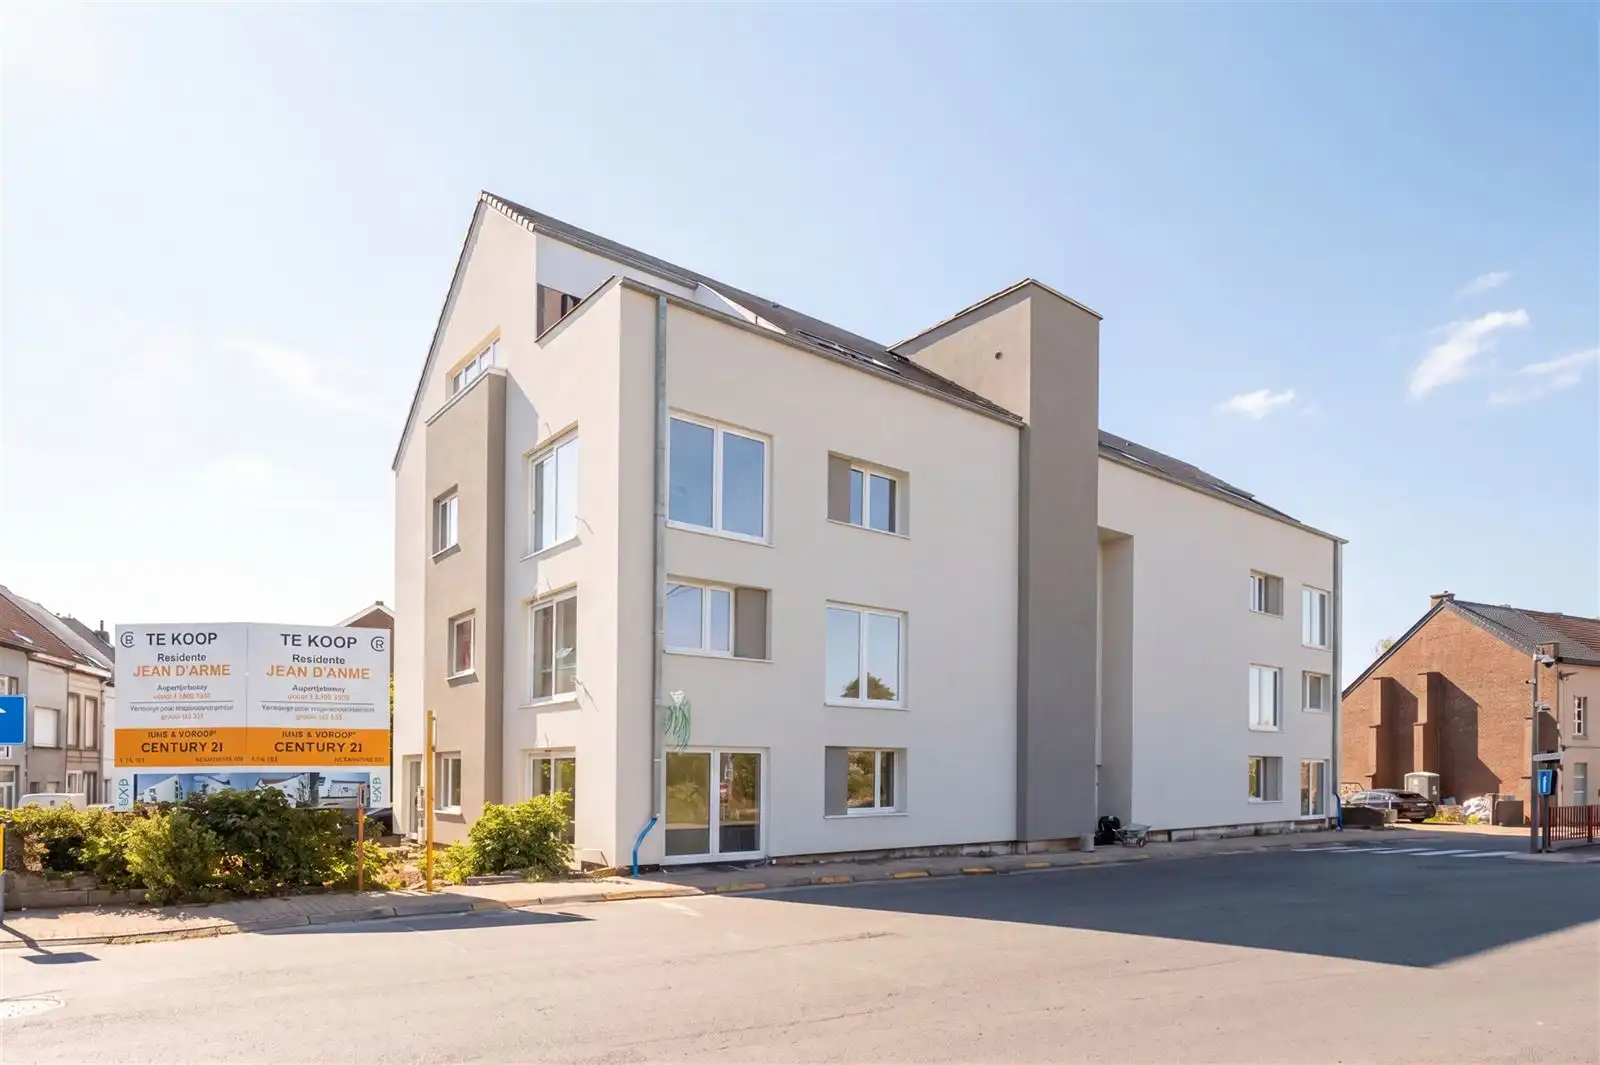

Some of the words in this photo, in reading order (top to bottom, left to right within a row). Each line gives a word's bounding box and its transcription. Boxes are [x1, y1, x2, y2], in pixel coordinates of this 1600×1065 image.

[146, 633, 166, 646] TE
[172, 632, 218, 646] KOOP
[280, 633, 302, 647] TE
[308, 634, 357, 649] KOOP
[133, 665, 171, 677] JEAN
[266, 665, 307, 678] JEAN
[141, 742, 207, 753] CENTURY
[211, 741, 223, 753] 21
[274, 742, 346, 753] CENTURY
[350, 742, 362, 753] 21
